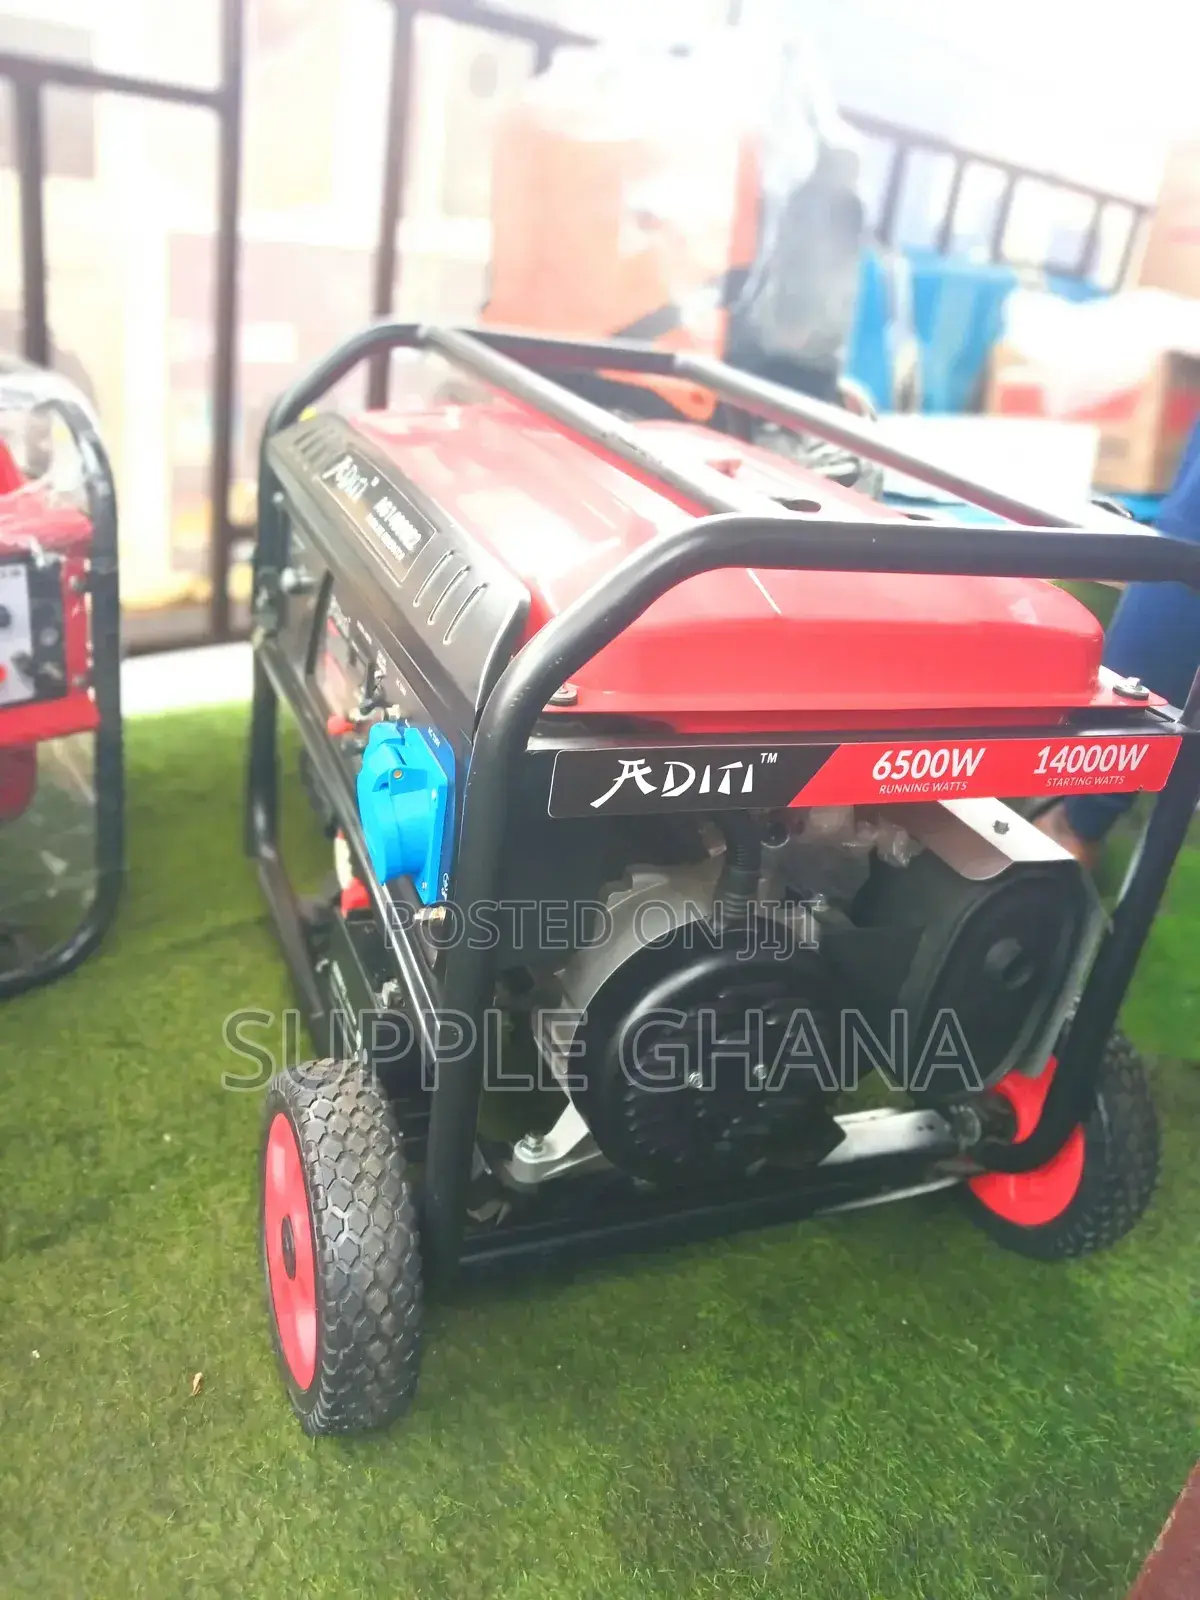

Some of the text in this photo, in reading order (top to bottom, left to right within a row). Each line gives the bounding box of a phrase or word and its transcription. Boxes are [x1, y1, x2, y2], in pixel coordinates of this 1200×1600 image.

[871, 747, 987, 781] 6500W
[1032, 743, 1150, 775] 14000W
[589, 758, 755, 809] ADITI
[878, 780, 969, 795] RUNNING WATTS
[1045, 774, 1126, 788] STARTING WATTS
